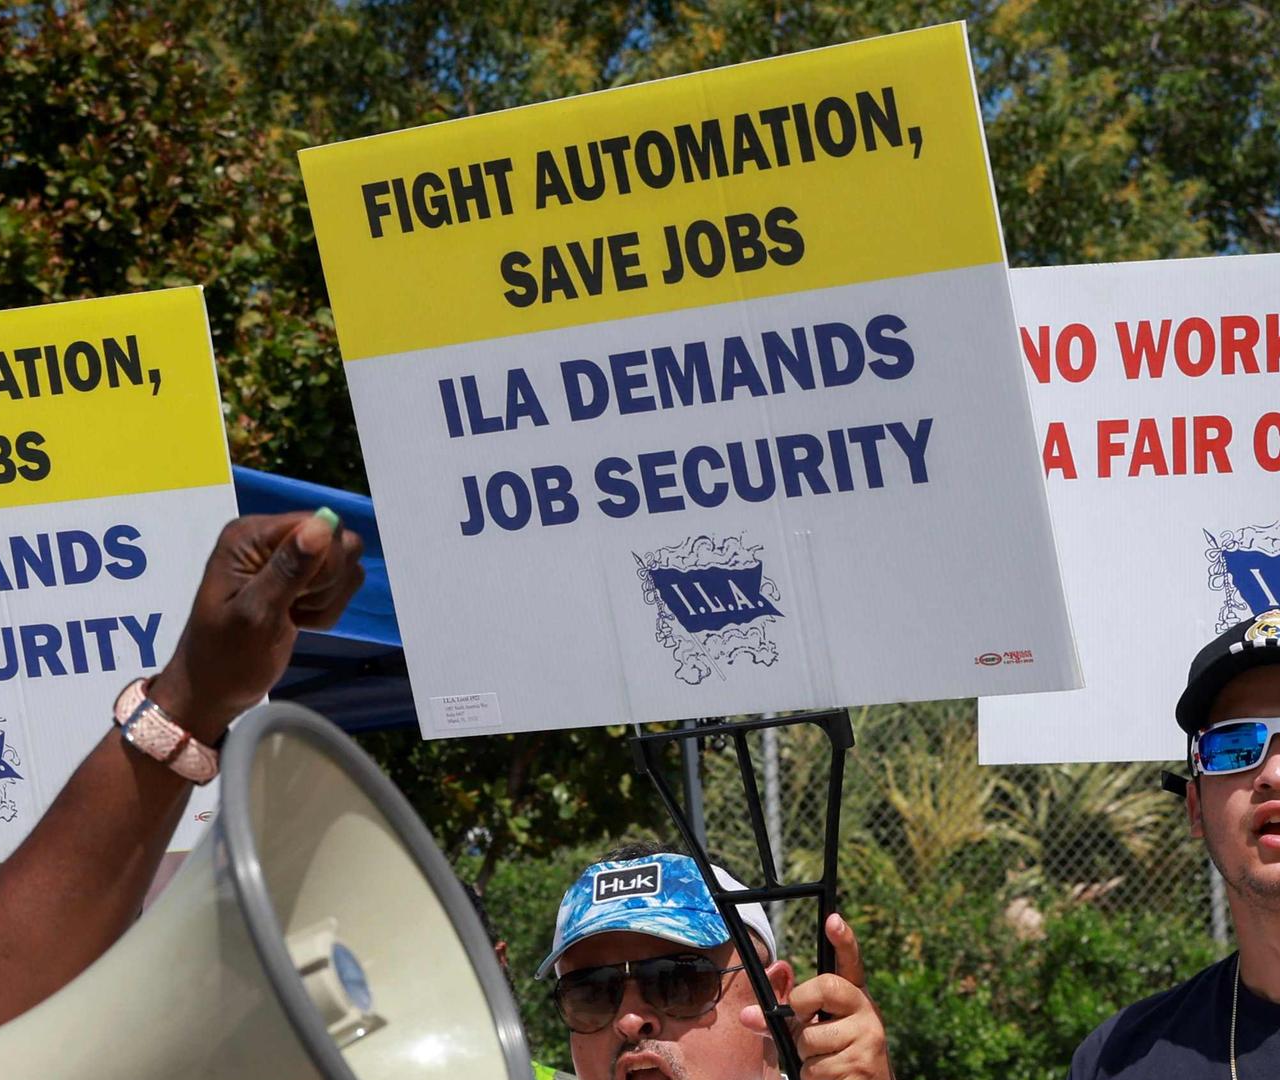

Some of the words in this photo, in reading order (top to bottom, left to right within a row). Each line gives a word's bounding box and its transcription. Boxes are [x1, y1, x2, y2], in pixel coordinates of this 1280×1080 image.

[361, 158, 514, 239] FIGHT
[535, 87, 924, 210] AUTOMATION,
[500, 231, 649, 308] SAVE
[661, 206, 806, 285] JOBS
[440, 360, 550, 439] ILA
[563, 315, 916, 420] DEMANDS
[1019, 323, 1097, 384] NO
[460, 465, 579, 536] JOB
[596, 418, 933, 519] SECURITY
[1042, 422, 1078, 480] A
[1097, 415, 1233, 478] FAIR
[670, 579, 765, 616] I.L.A.
